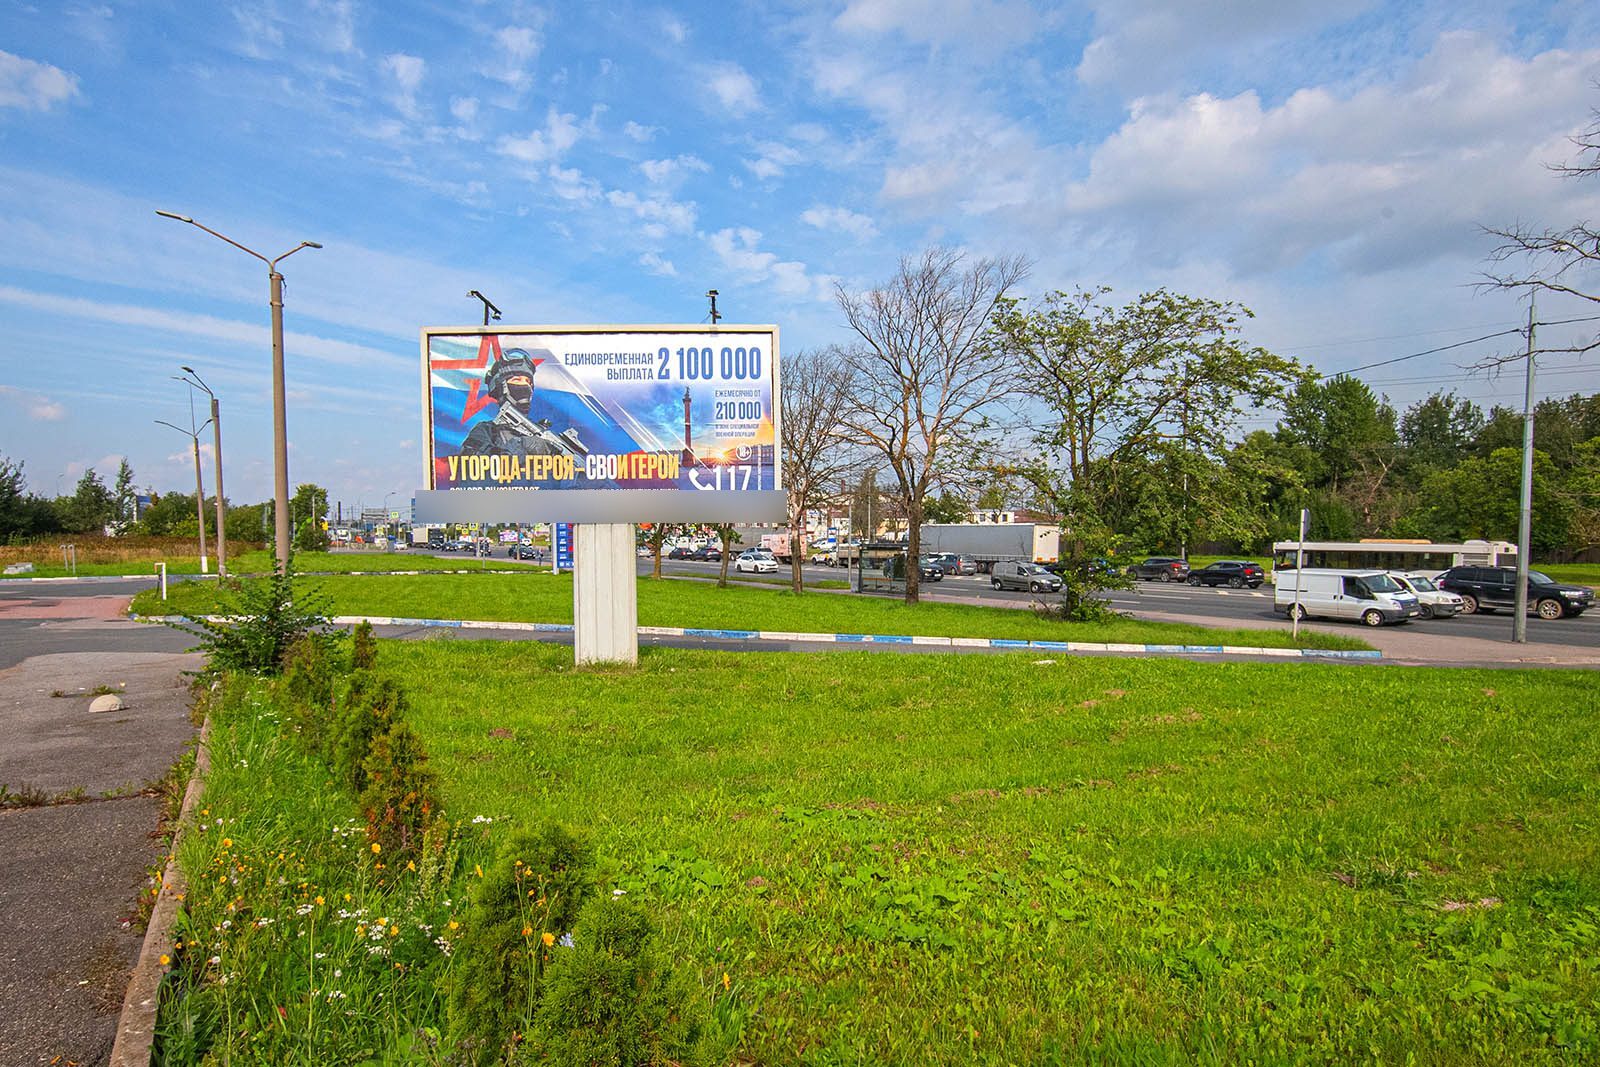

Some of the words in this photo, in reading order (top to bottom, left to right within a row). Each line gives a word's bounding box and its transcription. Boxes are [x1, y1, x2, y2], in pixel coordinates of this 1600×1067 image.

[564, 352, 654, 366] ЕДИНОВРЕМЕННАЯ
[658, 347, 670, 380] 2
[676, 347, 714, 380] 100
[720, 347, 761, 380] 000
[607, 368, 654, 380] ВЫПЛАТА
[715, 389, 753, 398] ЕЖЕМЕСЯЧНО
[754, 389, 761, 398] ОТ
[716, 402, 736, 420] 210
[738, 402, 761, 420] 000
[739, 446, 750, 456] 18+
[447, 455, 459, 481] У
[460, 454, 574, 483] ГОРОДА-ГЕРОЯ
[585, 454, 628, 480] СВОИ
[630, 454, 679, 480] ГЕРОИ
[713, 465, 752, 490] 117
